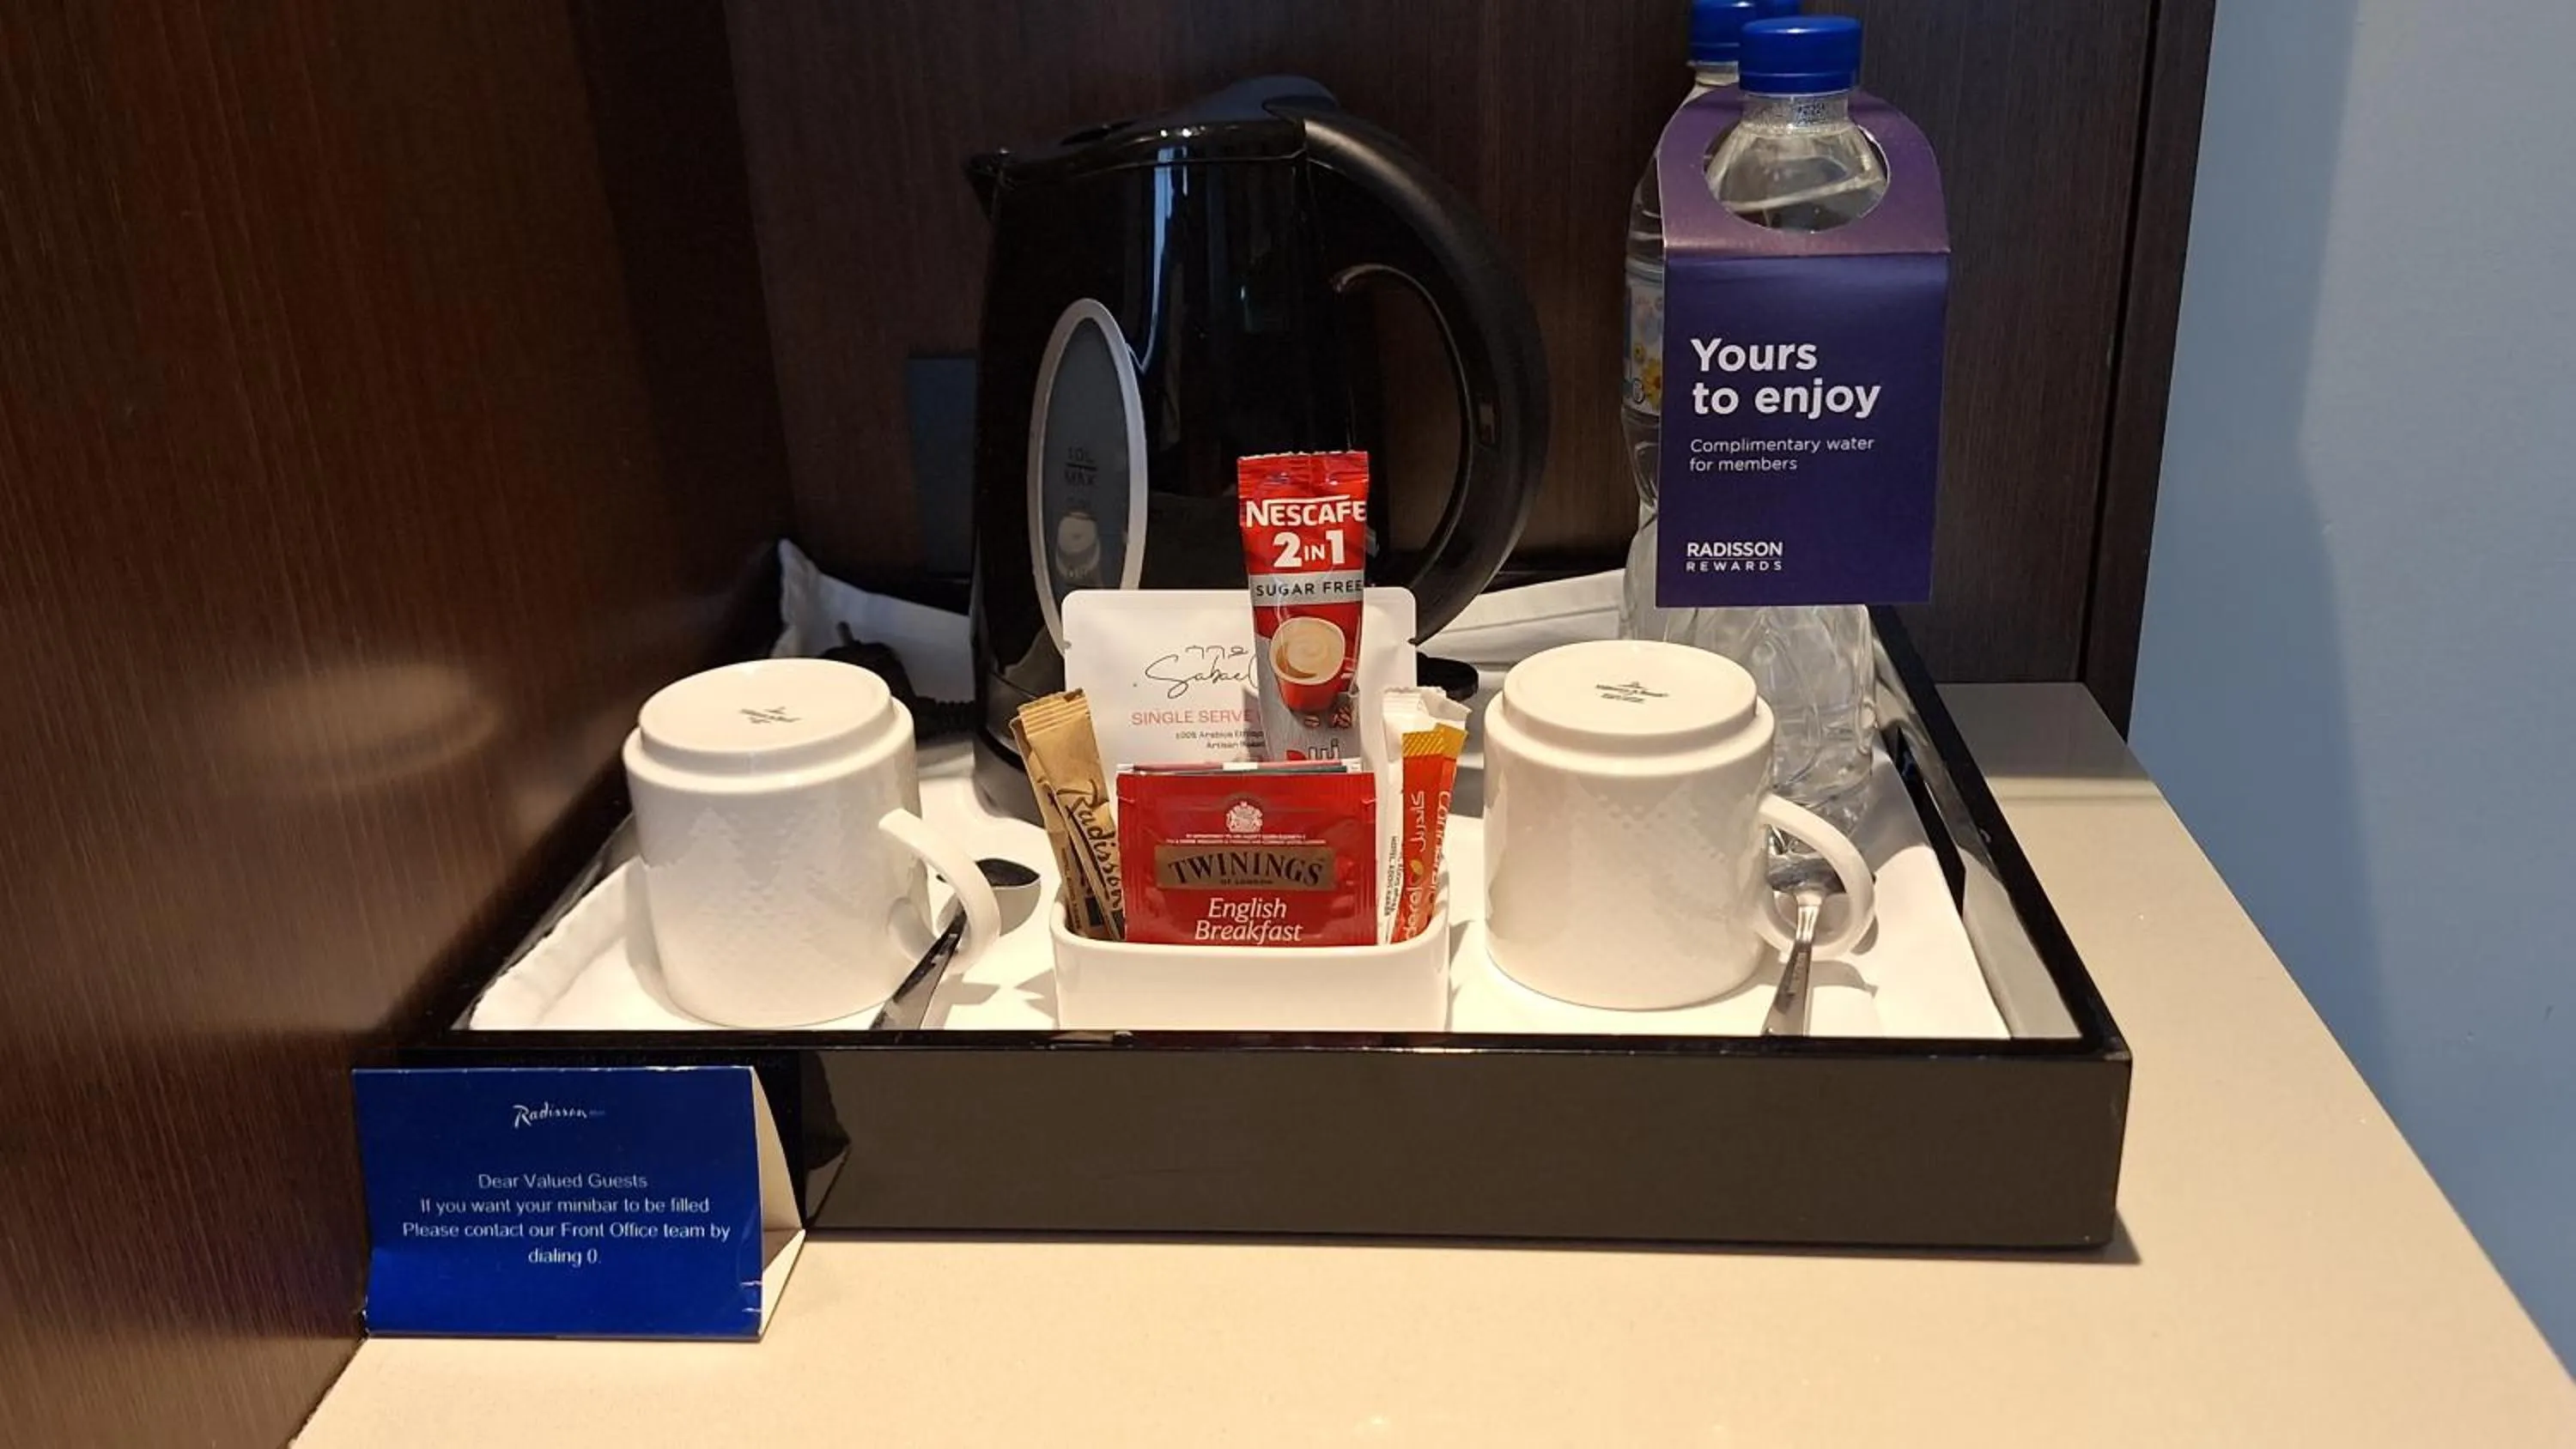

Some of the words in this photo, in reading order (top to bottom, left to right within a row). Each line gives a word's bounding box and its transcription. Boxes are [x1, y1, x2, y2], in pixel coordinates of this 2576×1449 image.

[1690, 337, 1818, 372] Yours
[1692, 382, 1740, 415] to
[1754, 377, 1881, 420] enjoy
[1690, 439, 1821, 454] Complimentary
[1826, 437, 1874, 451] water
[1689, 458, 1713, 471] for
[1718, 456, 1797, 471] members
[1686, 541, 1783, 557] RADISSON
[1686, 560, 1783, 573] REWARDS
[1255, 583, 1315, 597] SUGAR
[1323, 579, 1364, 593] FREE
[1132, 710, 1194, 725] SINGLE
[1198, 709, 1252, 724] SERVE
[1057, 779, 1122, 914] Radisson
[1168, 852, 1323, 887] TWININGS
[1208, 897, 1287, 924] English
[1194, 919, 1303, 945] Breakfast
[513, 1100, 587, 1129] Radisson
[478, 1173, 518, 1188] Dear
[523, 1173, 583, 1188] Valued
[588, 1173, 647, 1188] Guests
[421, 1199, 430, 1212] If
[436, 1203, 466, 1215] you
[471, 1199, 510, 1212] want
[516, 1202, 553, 1215] your
[557, 1198, 618, 1212] minibar
[624, 1198, 640, 1212] to
[645, 1197, 666, 1212] be
[671, 1197, 711, 1212] filled
[403, 1222, 459, 1237] Please
[465, 1223, 524, 1237] contact
[528, 1226, 555, 1237] our
[561, 1222, 605, 1237] Front
[609, 1222, 659, 1237] Office
[664, 1223, 706, 1237] team
[710, 1223, 731, 1241] by
[528, 1247, 582, 1266] dialing
